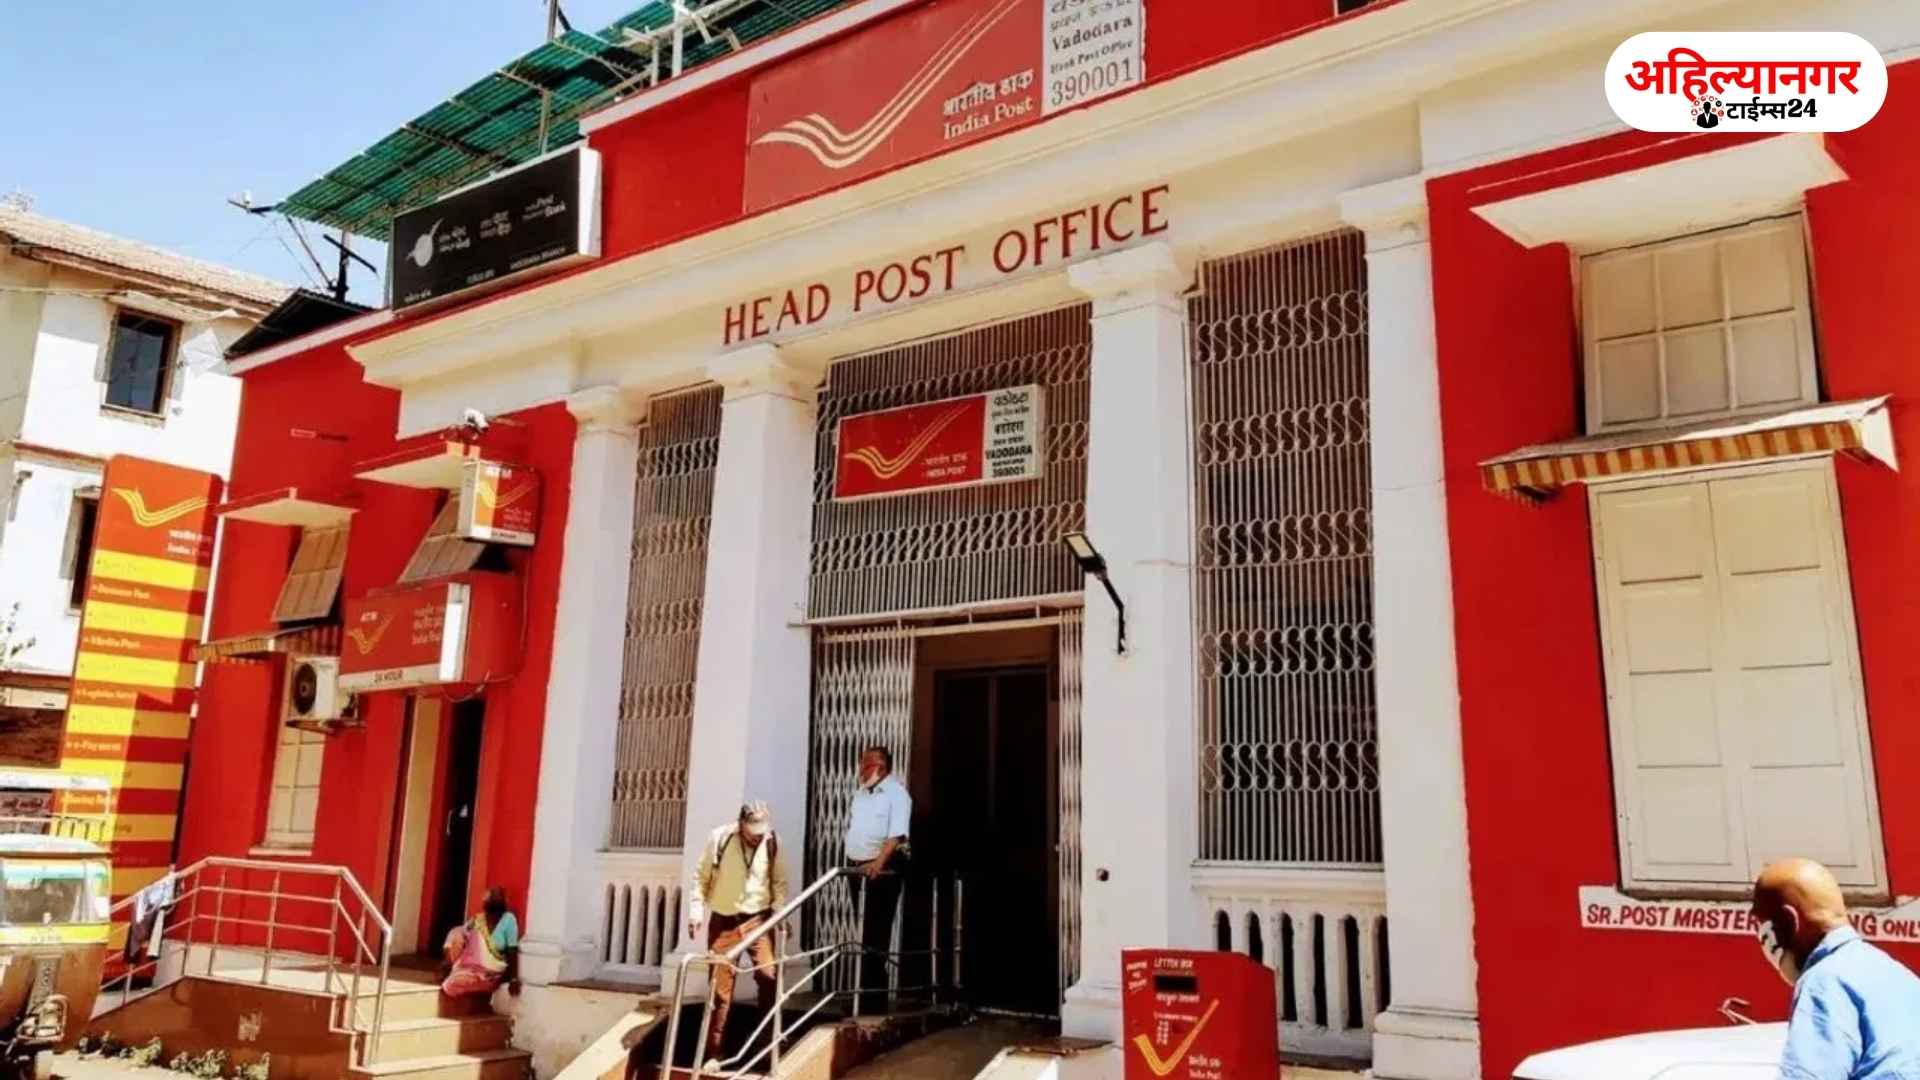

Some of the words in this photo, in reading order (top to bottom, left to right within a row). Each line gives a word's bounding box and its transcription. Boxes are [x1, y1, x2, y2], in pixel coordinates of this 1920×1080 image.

[1052, 58, 1134, 106] 390001
[943, 115, 990, 140] India
[994, 97, 1034, 122] Post
[723, 283, 831, 345] HEAD
[853, 245, 965, 312] POST
[993, 184, 1170, 274] OFFICE
[985, 445, 1033, 460] VADODARA
